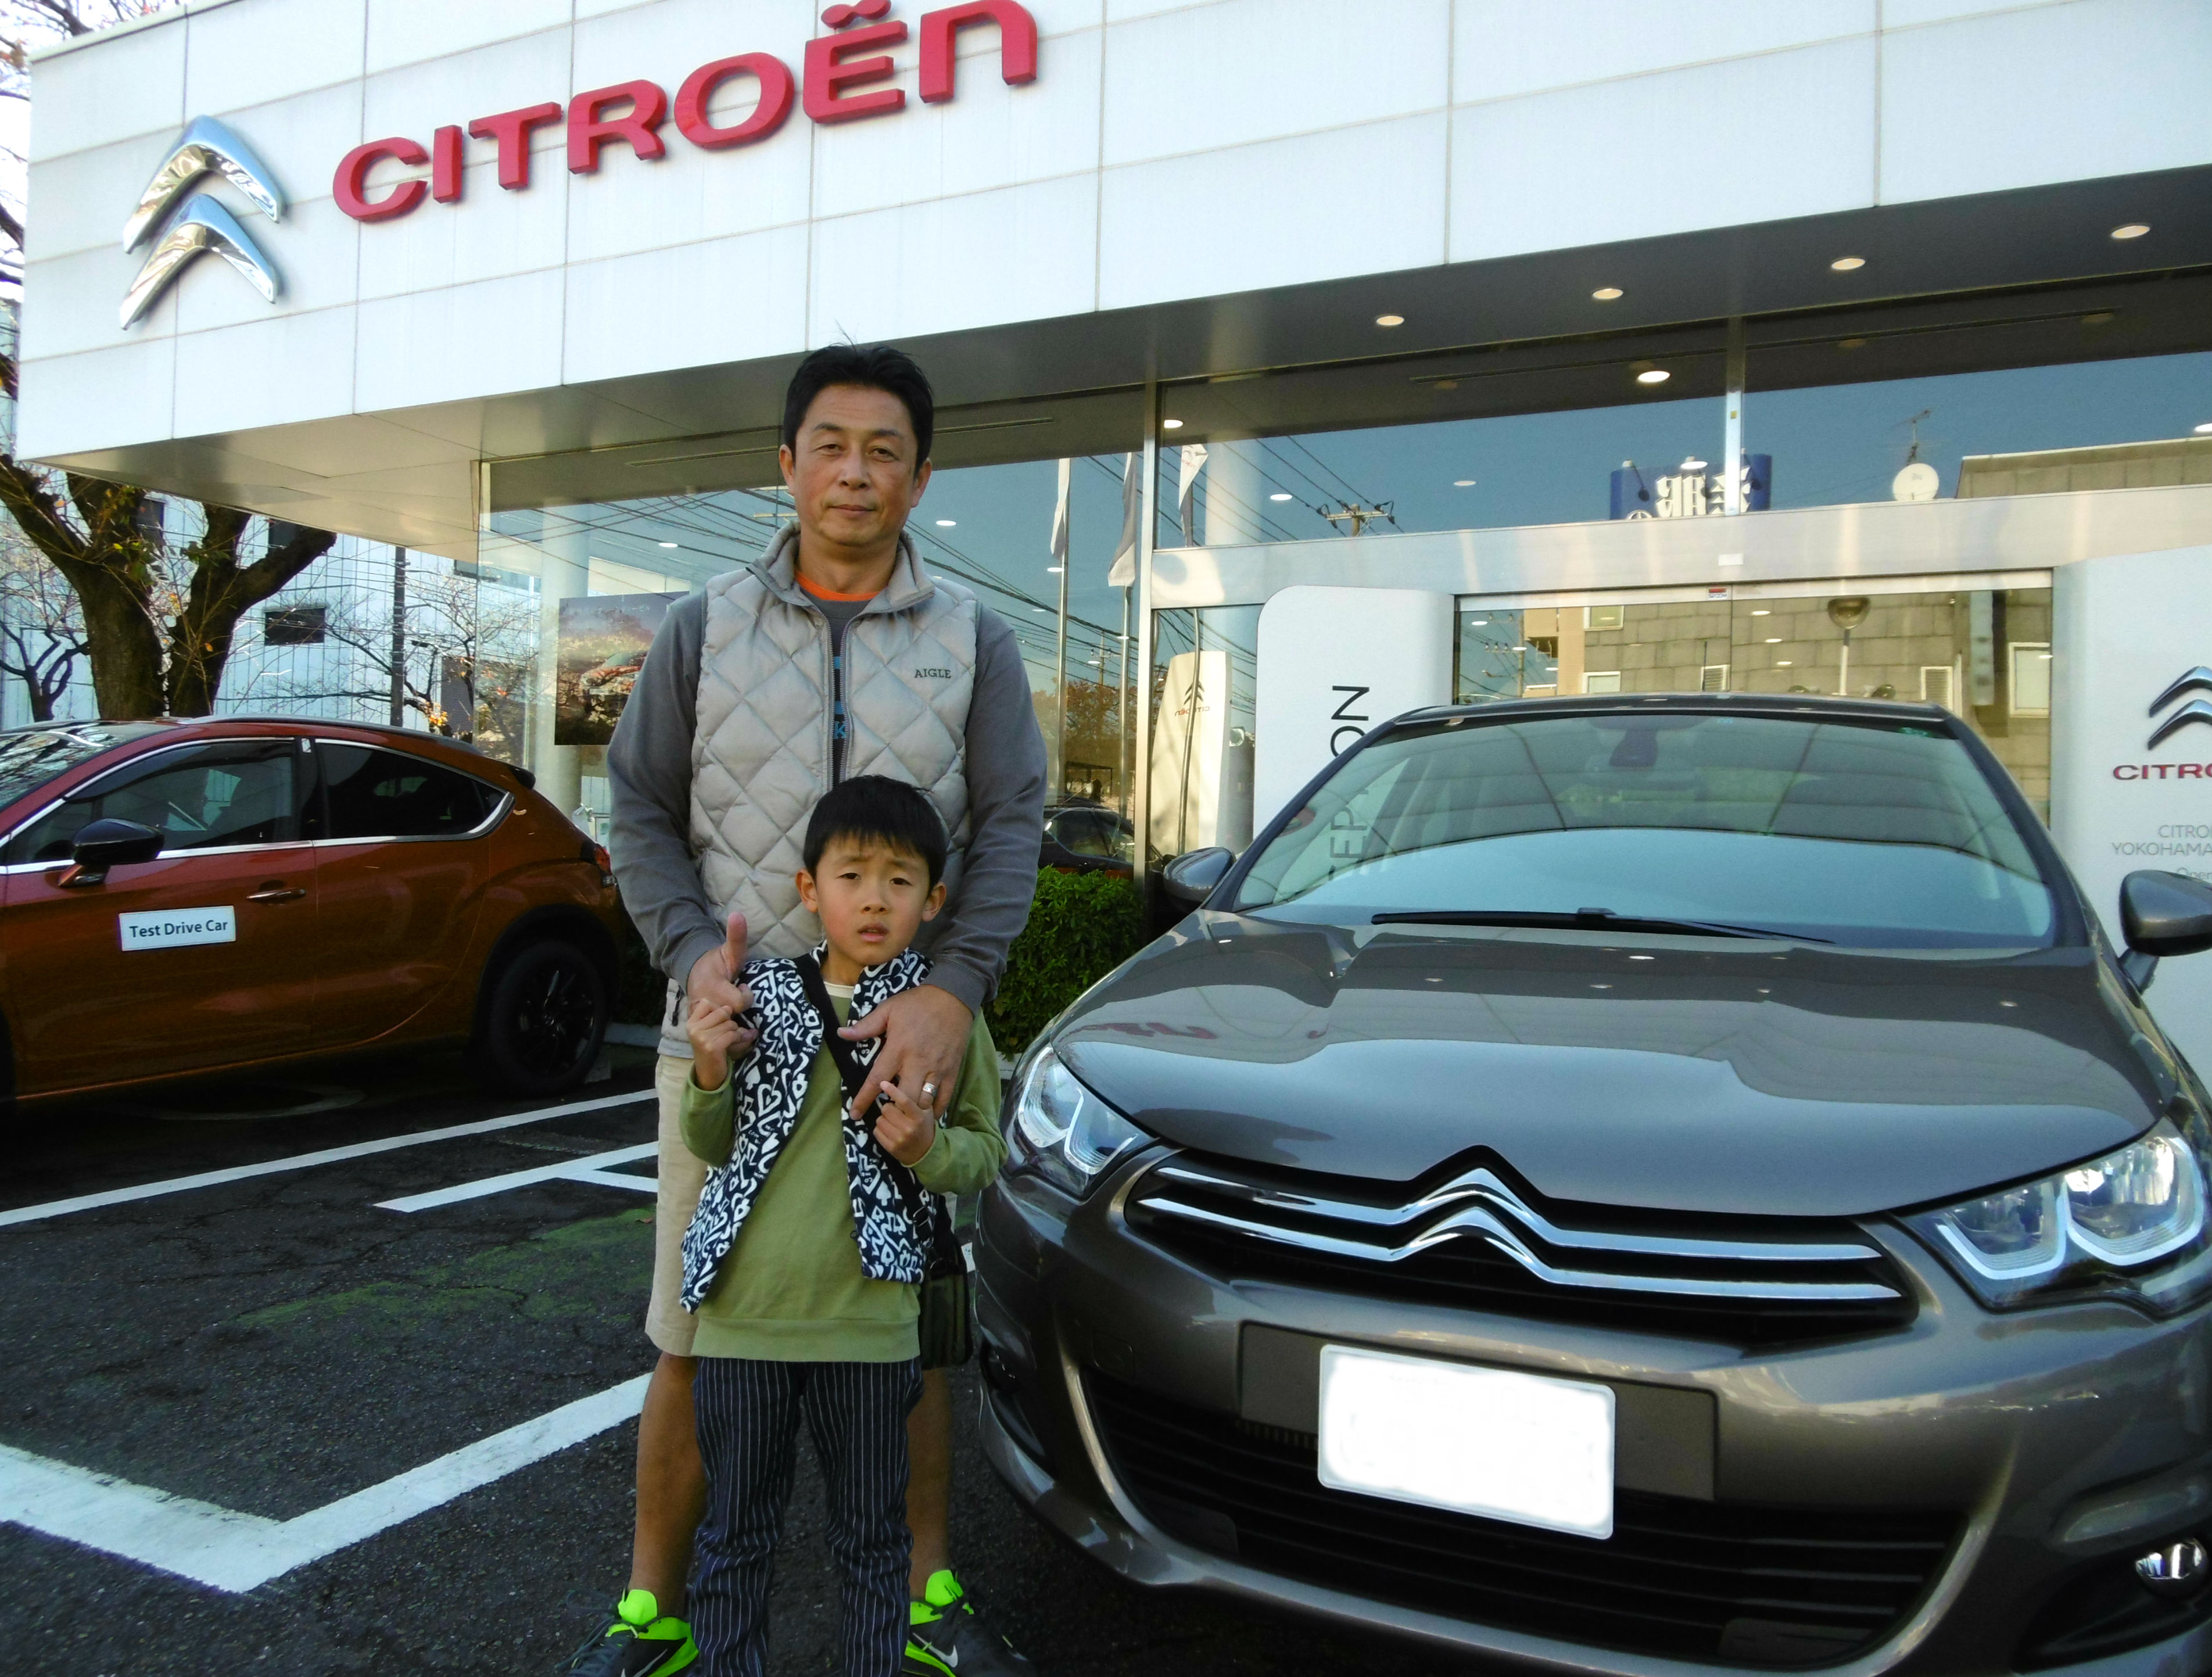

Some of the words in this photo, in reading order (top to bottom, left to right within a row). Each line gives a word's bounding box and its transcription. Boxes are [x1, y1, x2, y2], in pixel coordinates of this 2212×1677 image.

[914, 668, 952, 679] AIGLE
[2113, 764, 2212, 780] CITR
[129, 925, 161, 937] Test
[164, 922, 202, 935] Drive
[206, 919, 228, 933] Car
